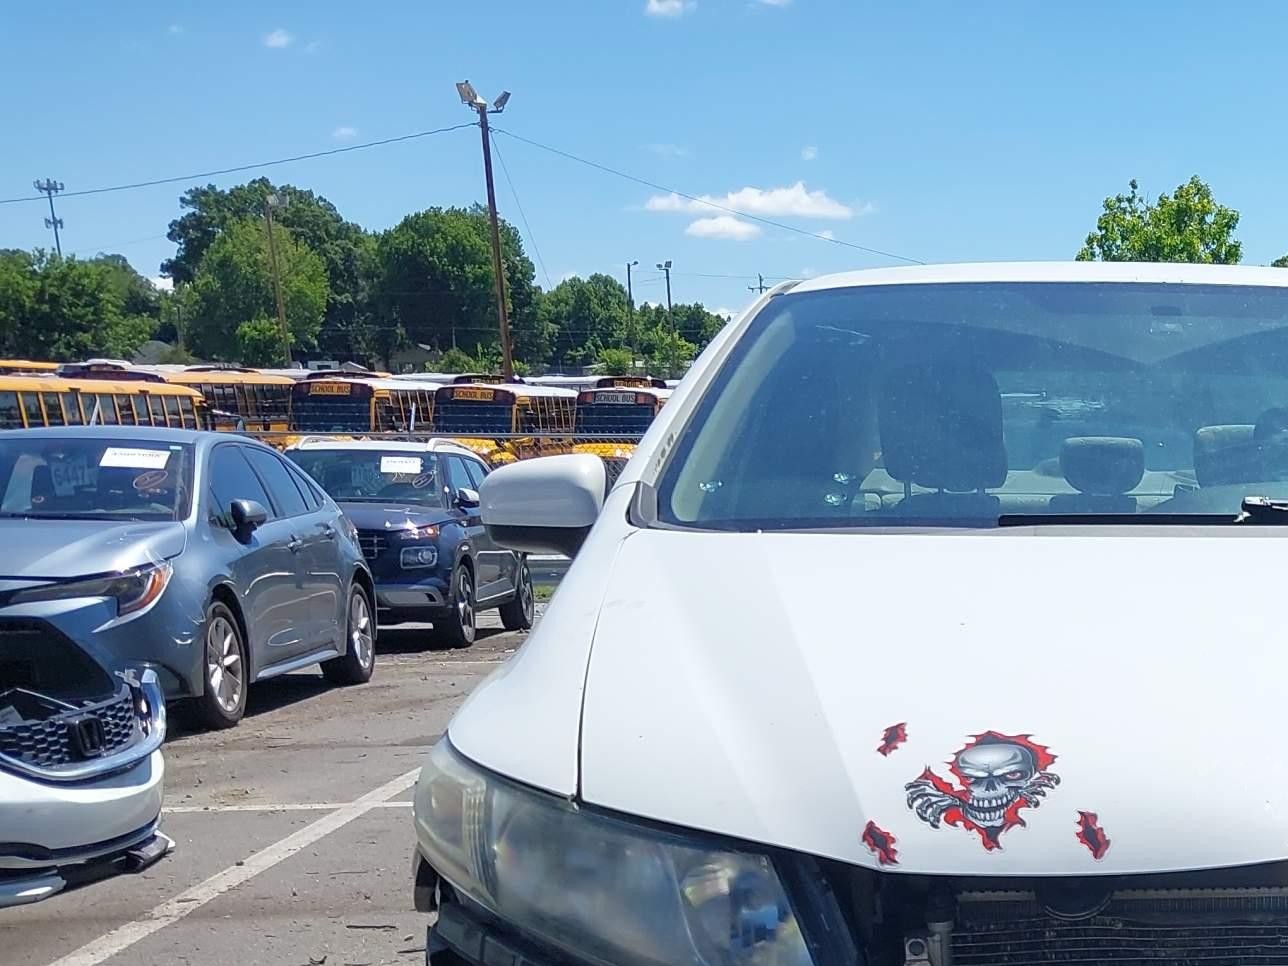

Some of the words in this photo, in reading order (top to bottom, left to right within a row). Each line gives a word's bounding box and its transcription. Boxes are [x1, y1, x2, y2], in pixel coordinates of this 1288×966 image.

[310, 384, 334, 393] SCHOOL
[337, 385, 350, 394] BUS
[454, 389, 478, 399] SCHOOL
[480, 391, 493, 400] BUS
[596, 393, 619, 402] SCHOOL
[622, 394, 635, 403] BUS
